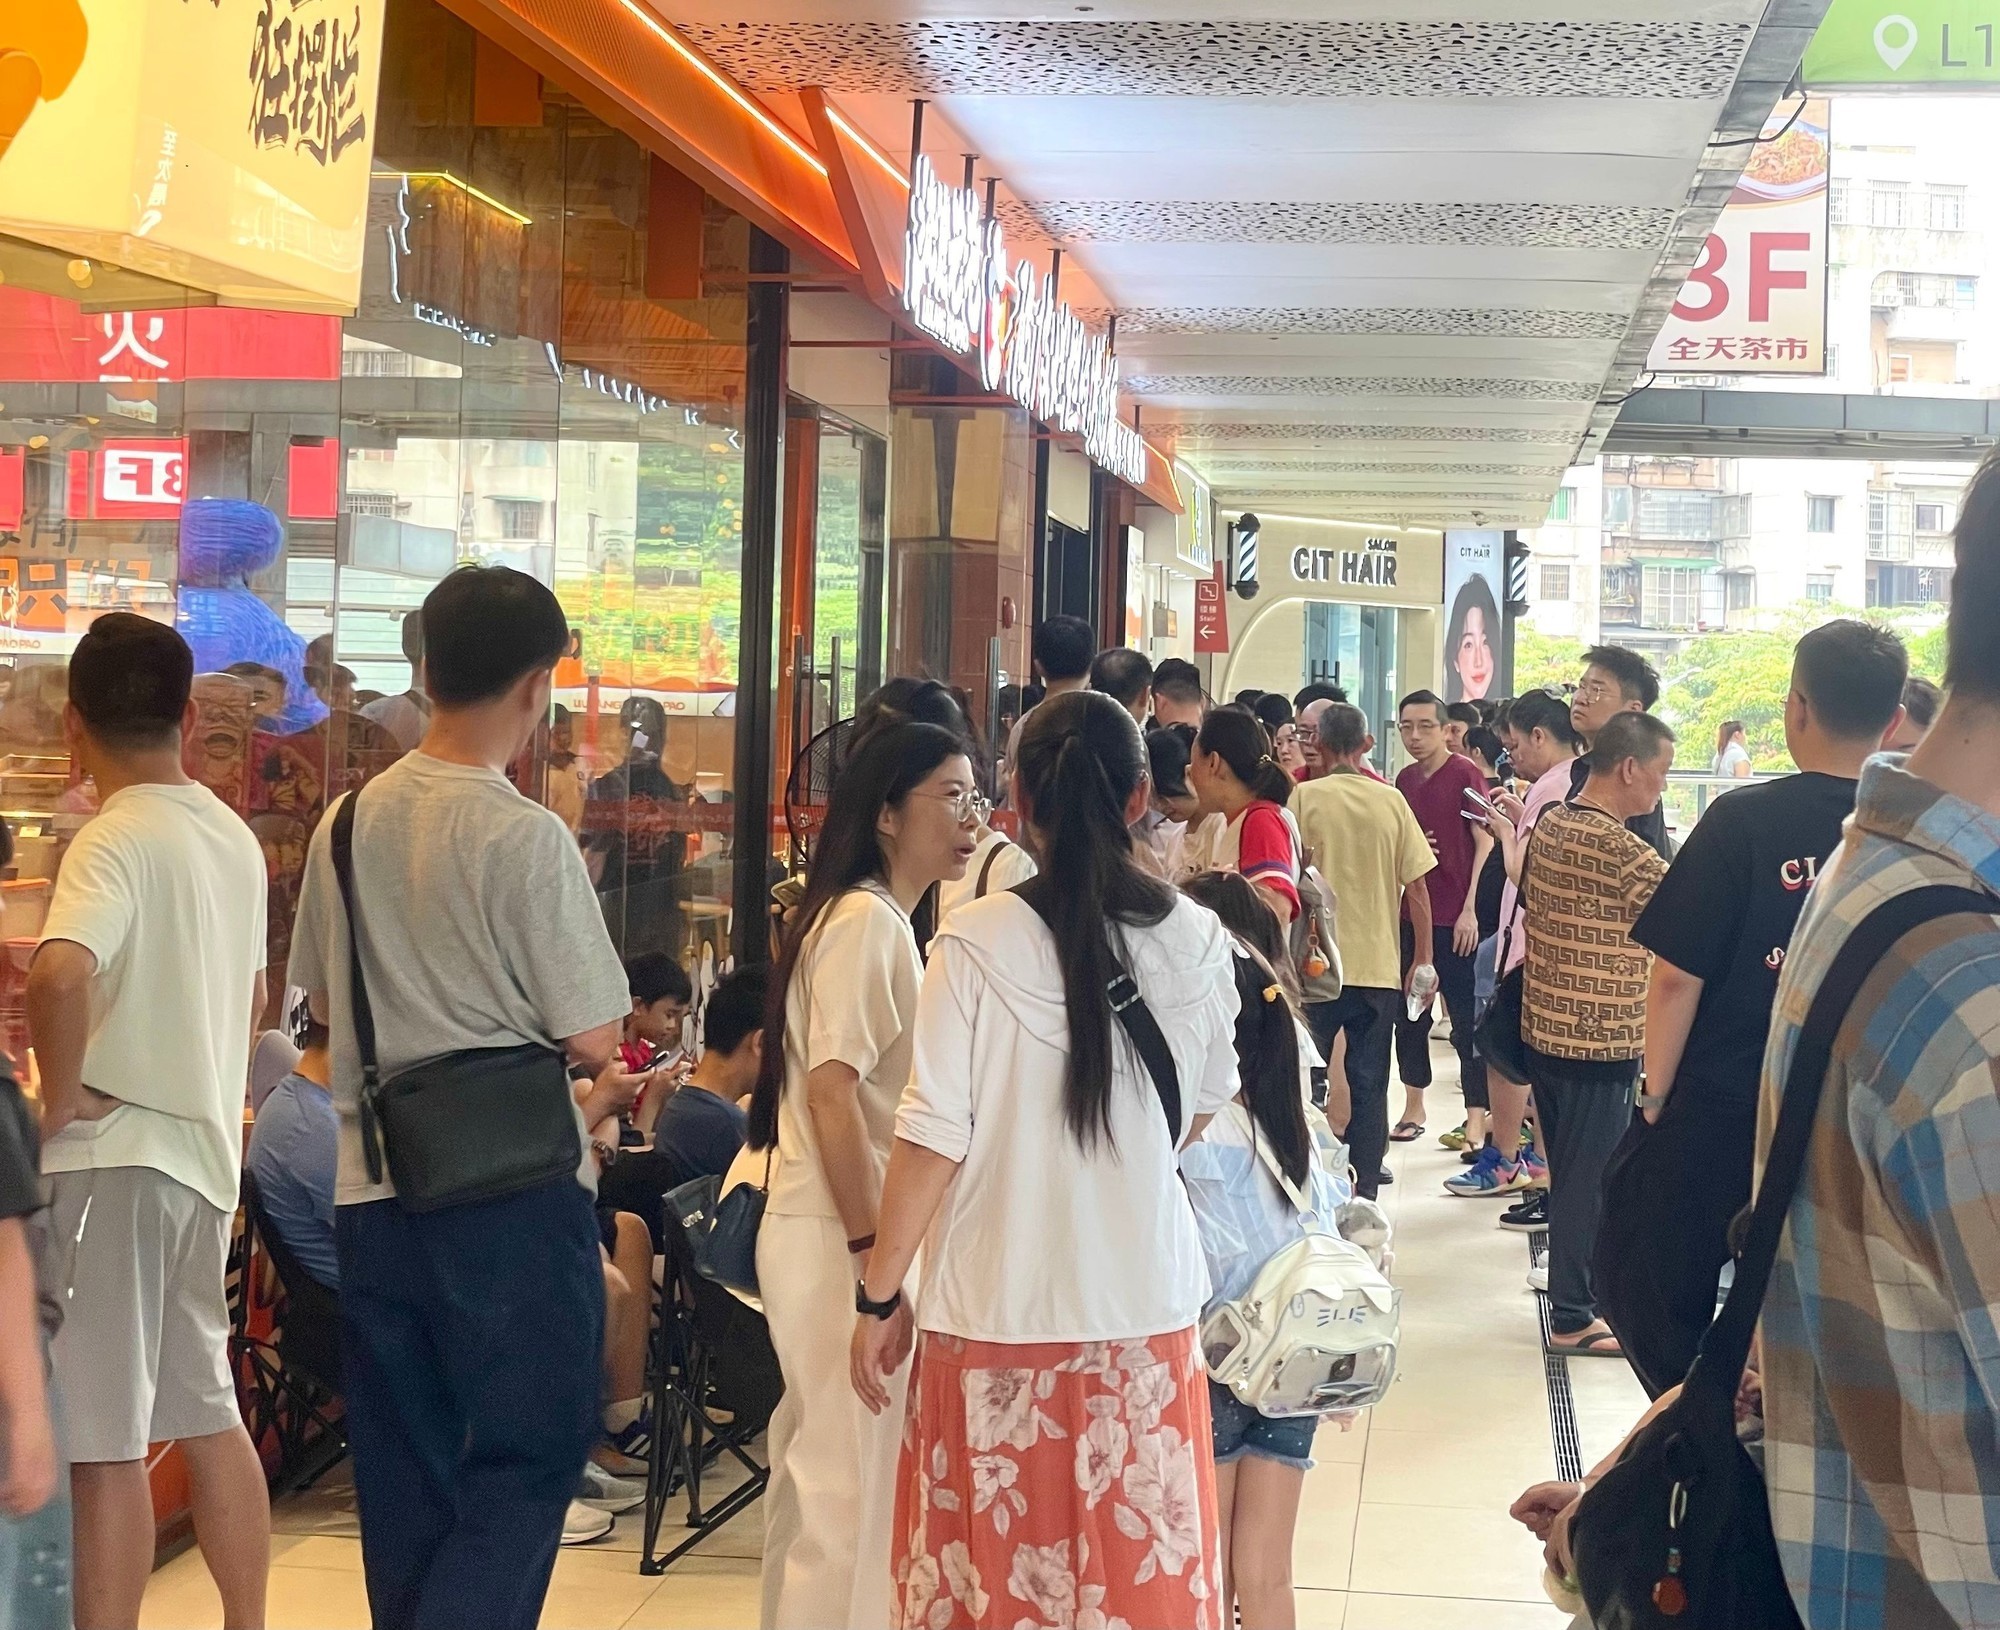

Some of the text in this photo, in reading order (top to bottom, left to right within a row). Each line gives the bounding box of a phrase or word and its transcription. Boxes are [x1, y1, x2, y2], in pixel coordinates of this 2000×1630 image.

[1941, 23, 1993, 68] L1
[1667, 336, 1809, 361] 全天茶市
[1293, 547, 1398, 587] CIT HAIR
[1460, 546, 1491, 558] CIT HAIR
